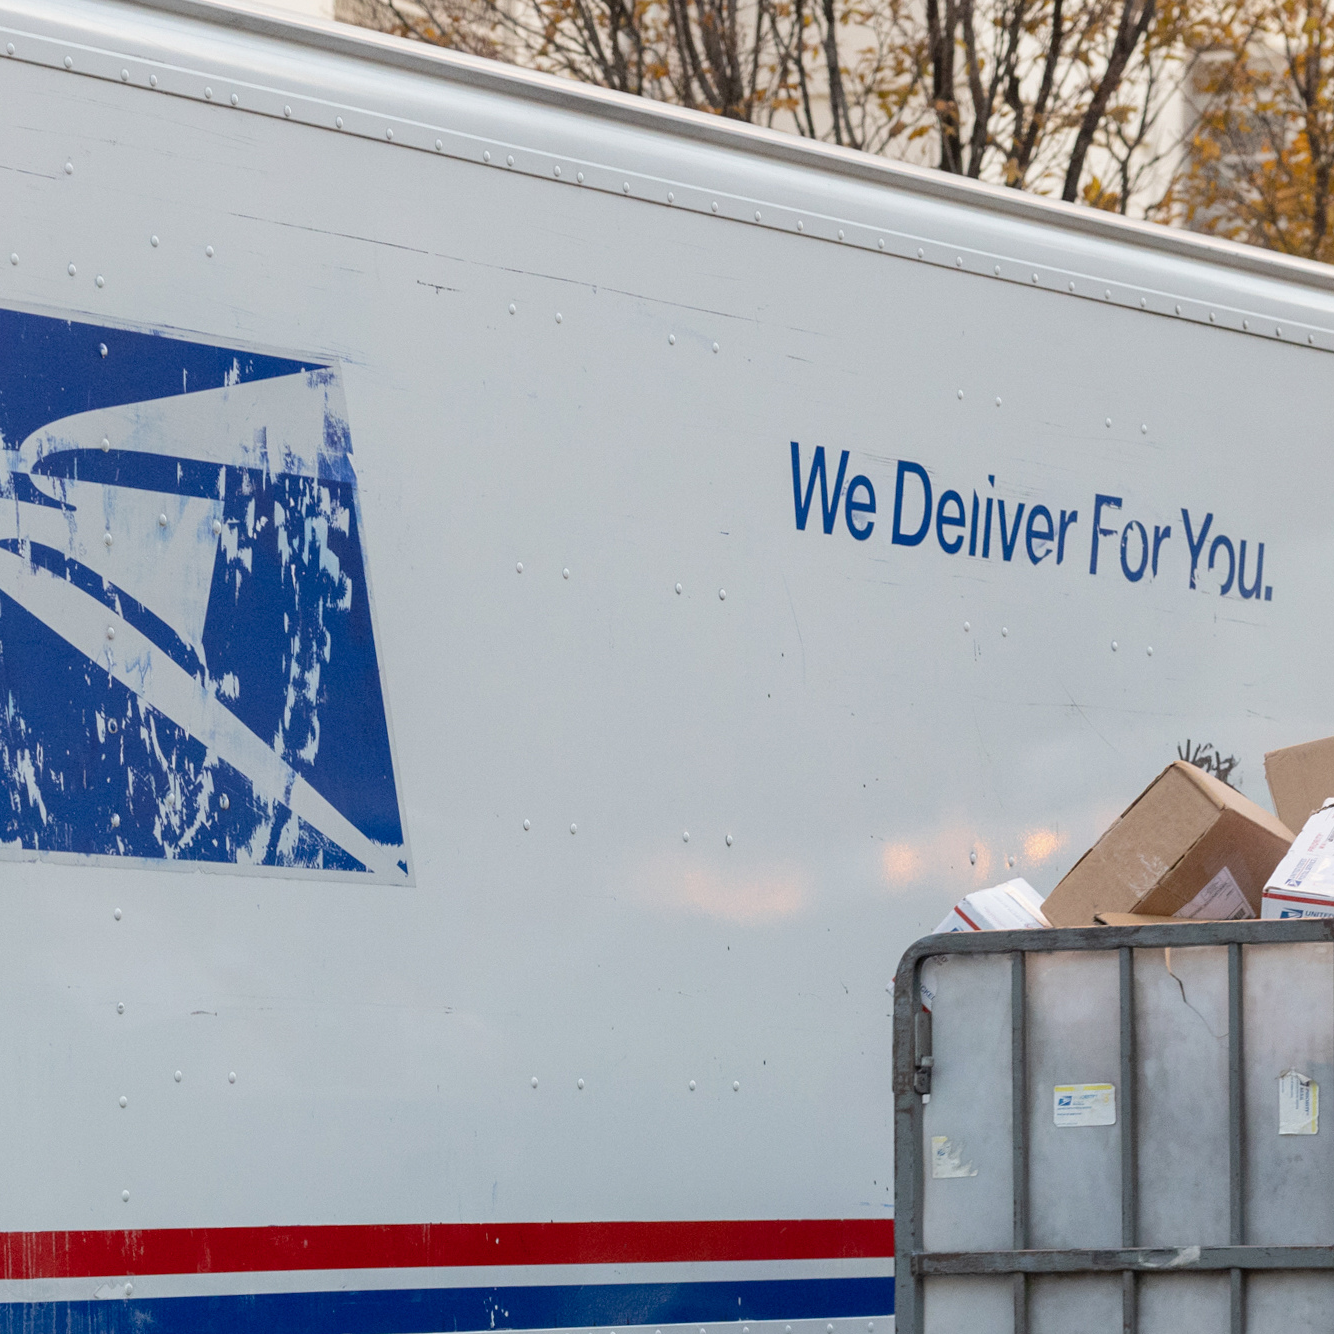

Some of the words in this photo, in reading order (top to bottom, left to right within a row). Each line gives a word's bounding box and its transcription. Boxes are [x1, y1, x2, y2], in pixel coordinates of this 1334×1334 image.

[789, 441, 877, 542] We
[890, 459, 1078, 566] Deliver
[1089, 493, 1172, 583] For
